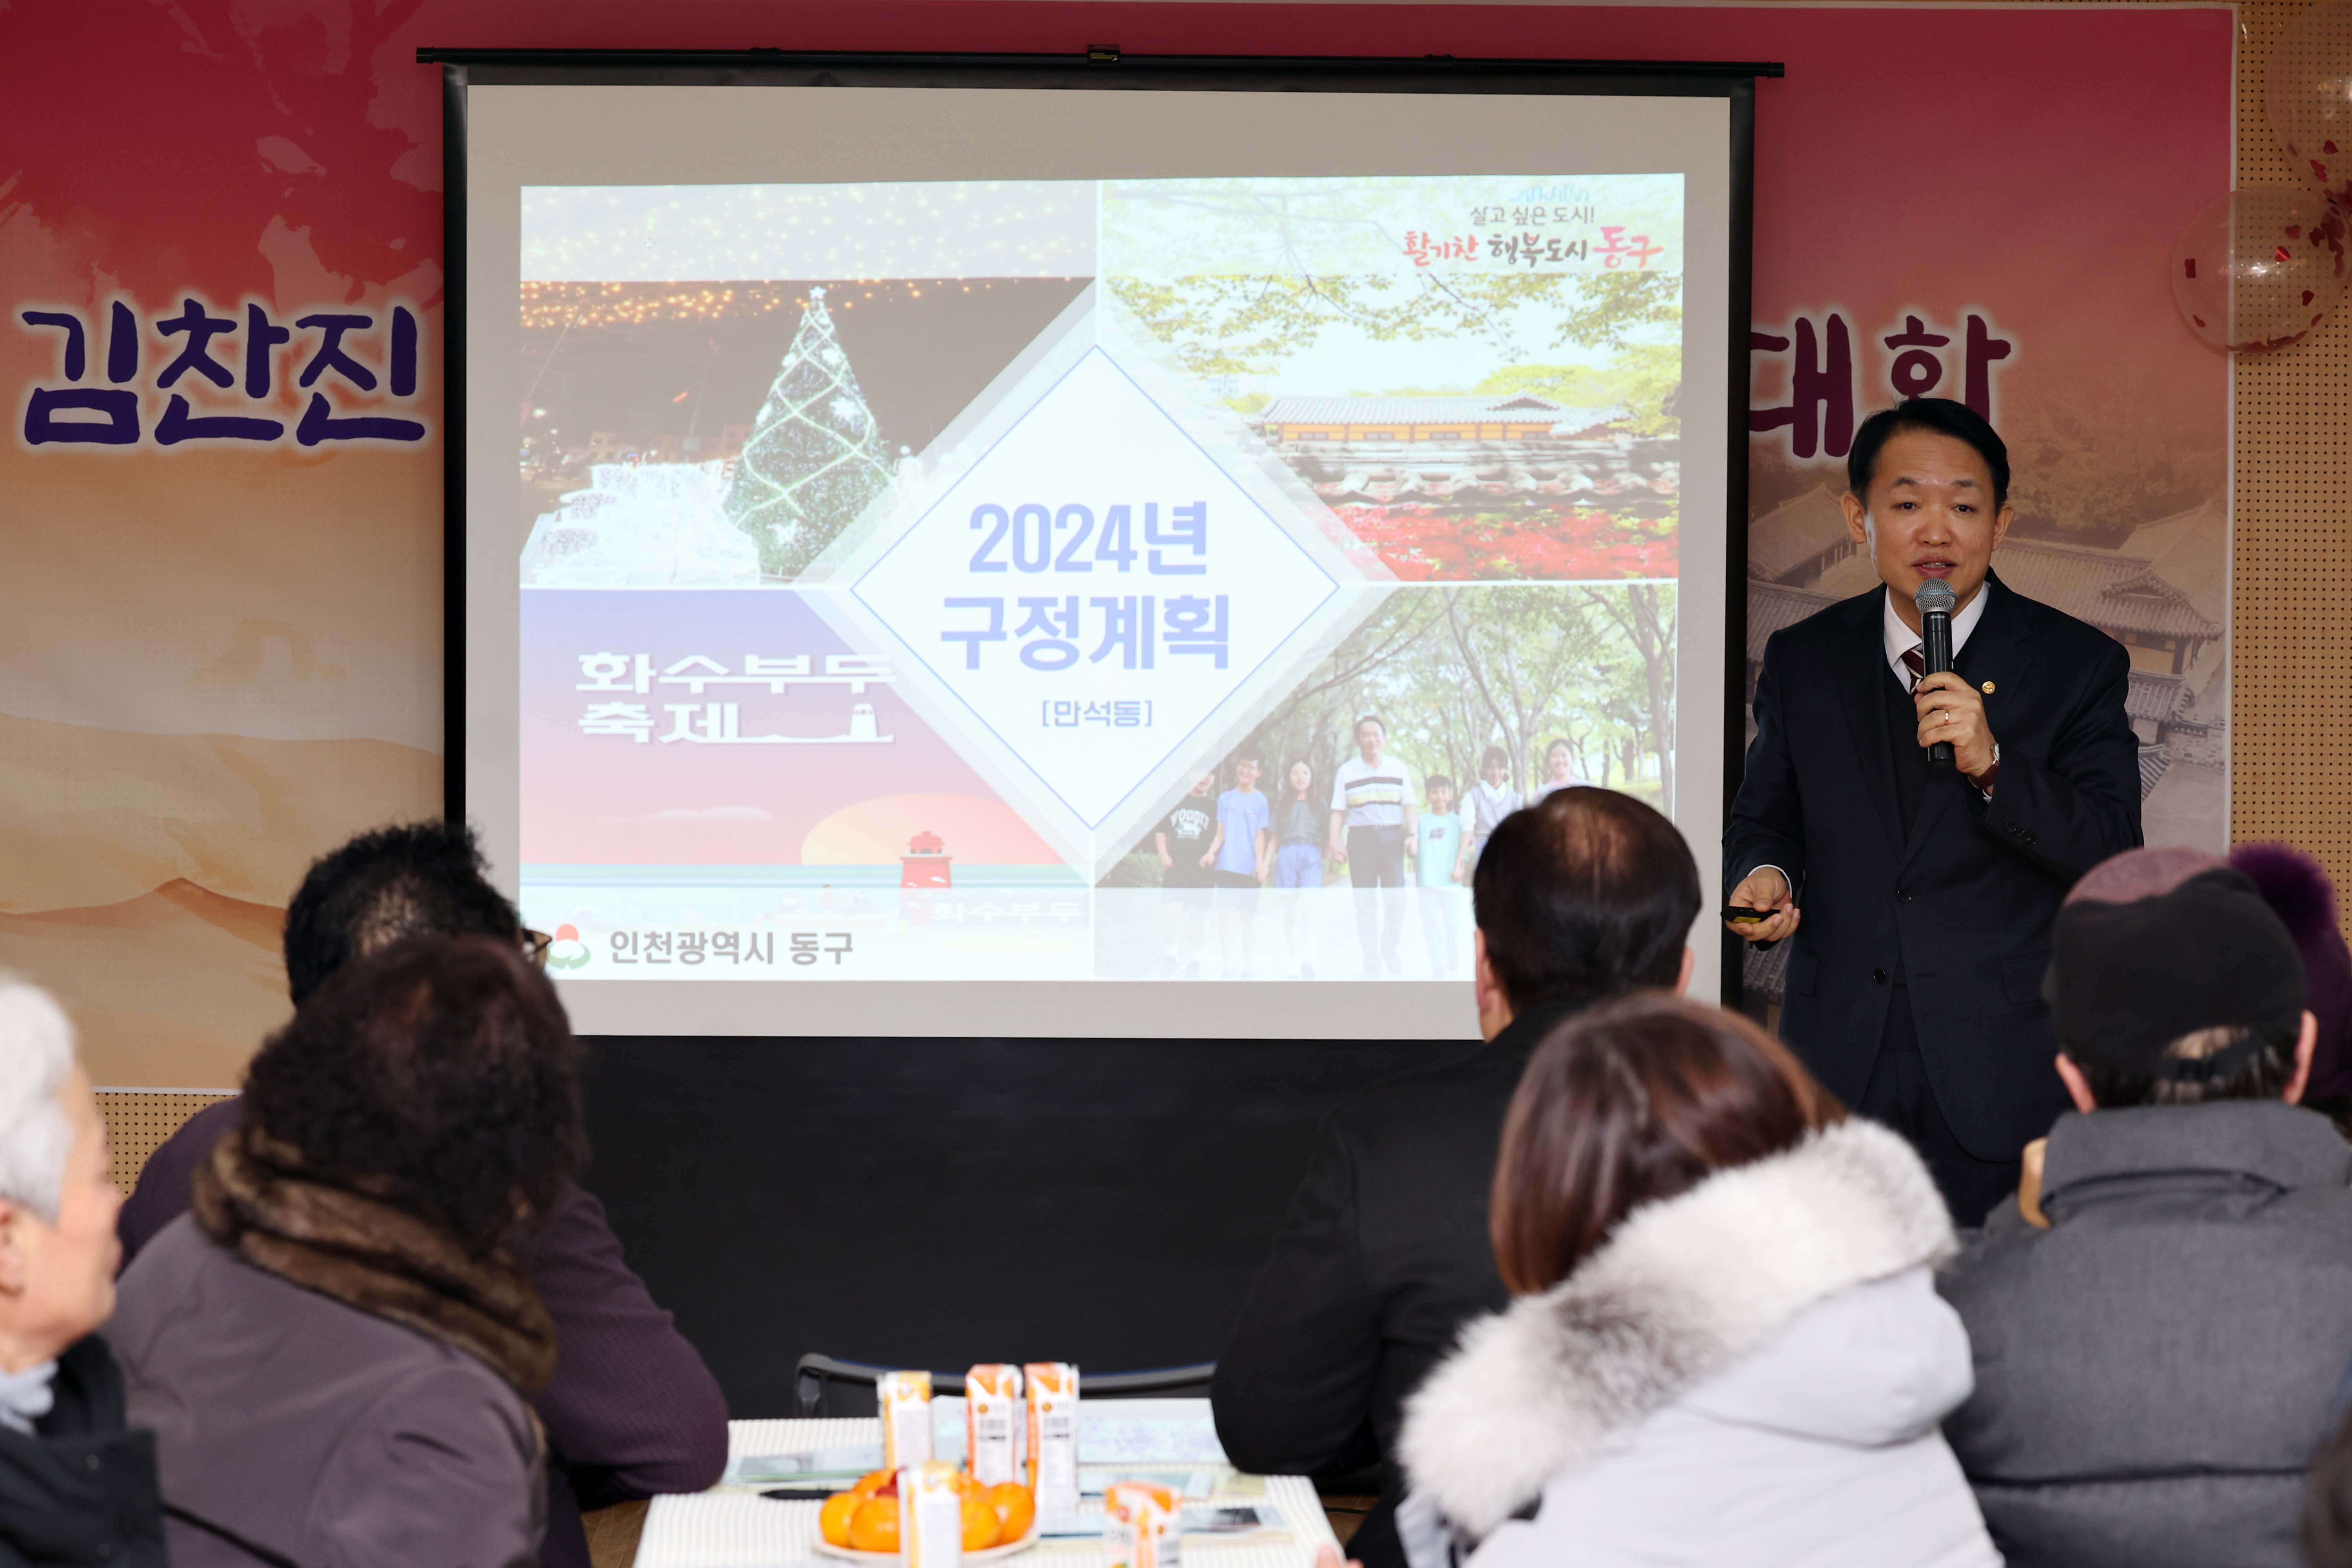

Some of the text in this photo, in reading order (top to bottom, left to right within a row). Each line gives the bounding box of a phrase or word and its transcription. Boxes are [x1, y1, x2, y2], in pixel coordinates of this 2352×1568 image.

[1470, 206, 1595, 226] 살고 싶은 도시!
[1402, 226, 1664, 268] 활기찬 행복도시 동구
[22, 298, 425, 446] 김찬진
[969, 500, 1207, 575] 2024년
[940, 595, 1229, 671] 구정계획
[575, 652, 896, 694] 화수부두
[578, 701, 740, 744] 축제
[1042, 700, 1152, 728] [만석동]
[610, 930, 855, 965] 인천광역시 동구
